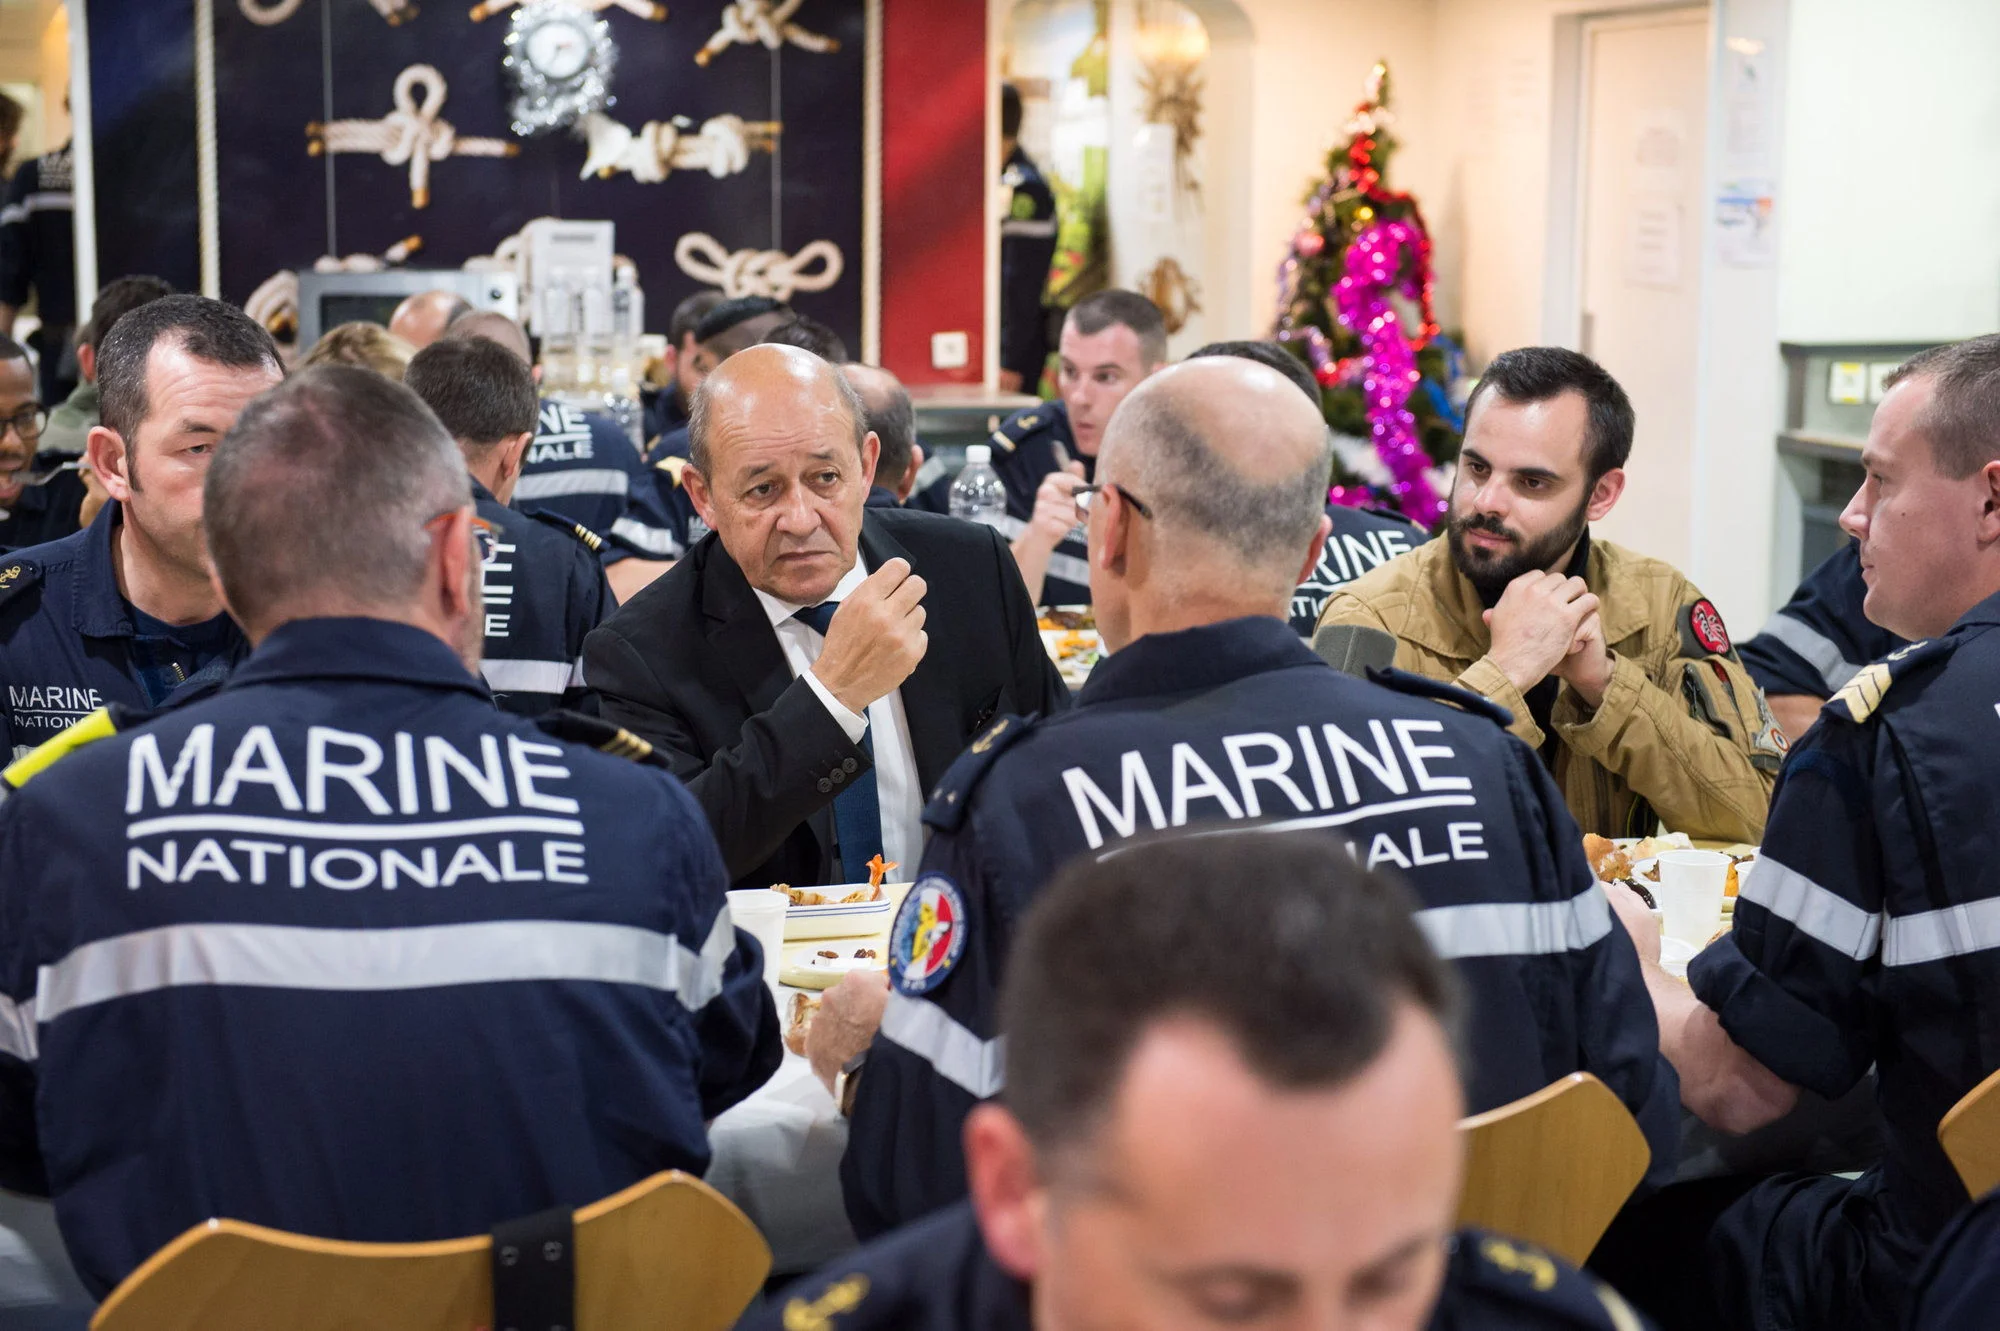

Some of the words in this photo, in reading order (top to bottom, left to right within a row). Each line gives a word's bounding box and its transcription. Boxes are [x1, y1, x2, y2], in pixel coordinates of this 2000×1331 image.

[8, 685, 105, 710] MARINE
[14, 715, 84, 729] NATION
[124, 723, 580, 816] MARINE
[1062, 719, 1473, 849] MARINE
[127, 839, 590, 891] NATIONALE
